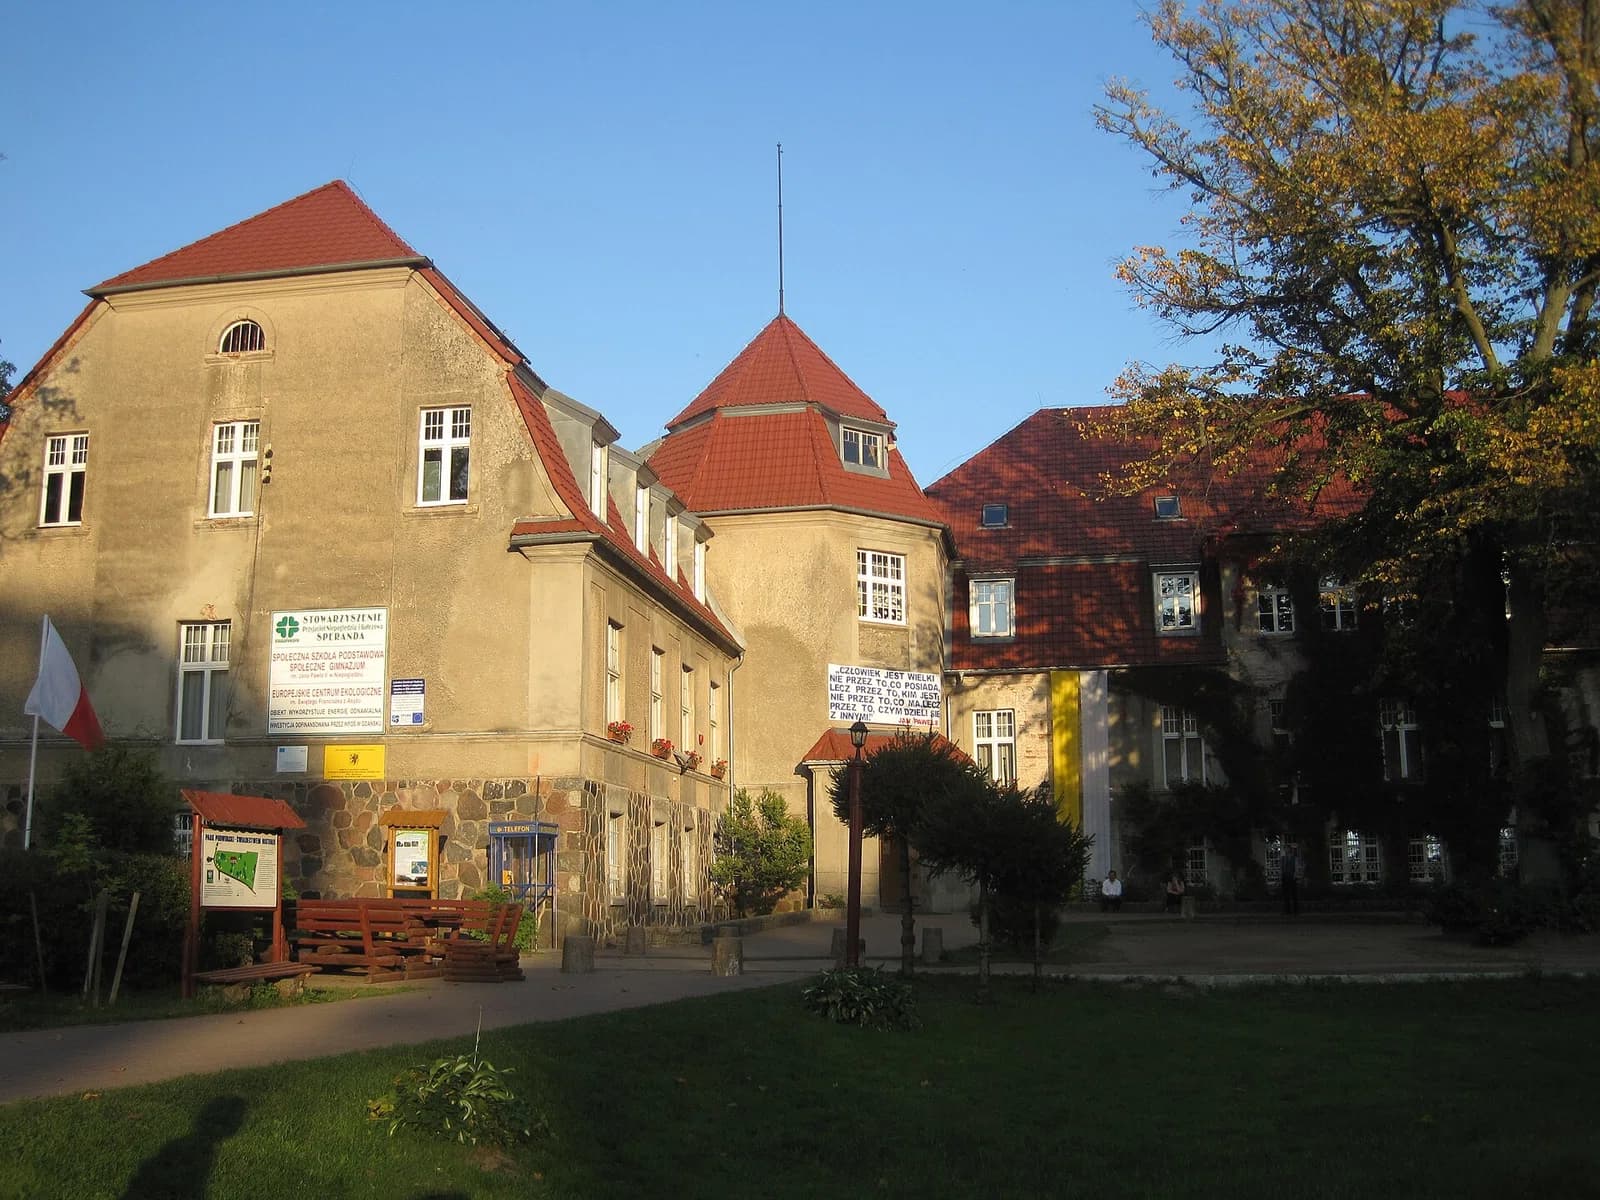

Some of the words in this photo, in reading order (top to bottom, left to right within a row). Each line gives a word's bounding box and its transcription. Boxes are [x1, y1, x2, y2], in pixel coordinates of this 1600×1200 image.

[303, 613, 382, 624] STOWARZYSZENIE
[316, 632, 365, 641] SPERANDA
[272, 653, 309, 661] SPOŁECZNA
[312, 652, 336, 660] SZKOŁA
[339, 650, 384, 660] PODSTAWOWA
[290, 663, 325, 671] SPOŁECZNE
[330, 662, 366, 670] GIMNAZJUM
[830, 674, 844, 683] NIE
[846, 676, 872, 685] PRZEZ
[884, 672, 904, 680] JEST
[908, 673, 935, 682] WIELKI
[272, 689, 310, 698] EUROPEJSKIE
[312, 688, 340, 697] CENTRUM
[341, 687, 382, 696] EKOLOGICZNE
[830, 684, 850, 692] LECZ
[856, 686, 882, 695] PRZEZ
[848, 695, 874, 704] PRZEZ
[830, 702, 856, 712] PRZEZ
[878, 706, 902, 715] CZYM
